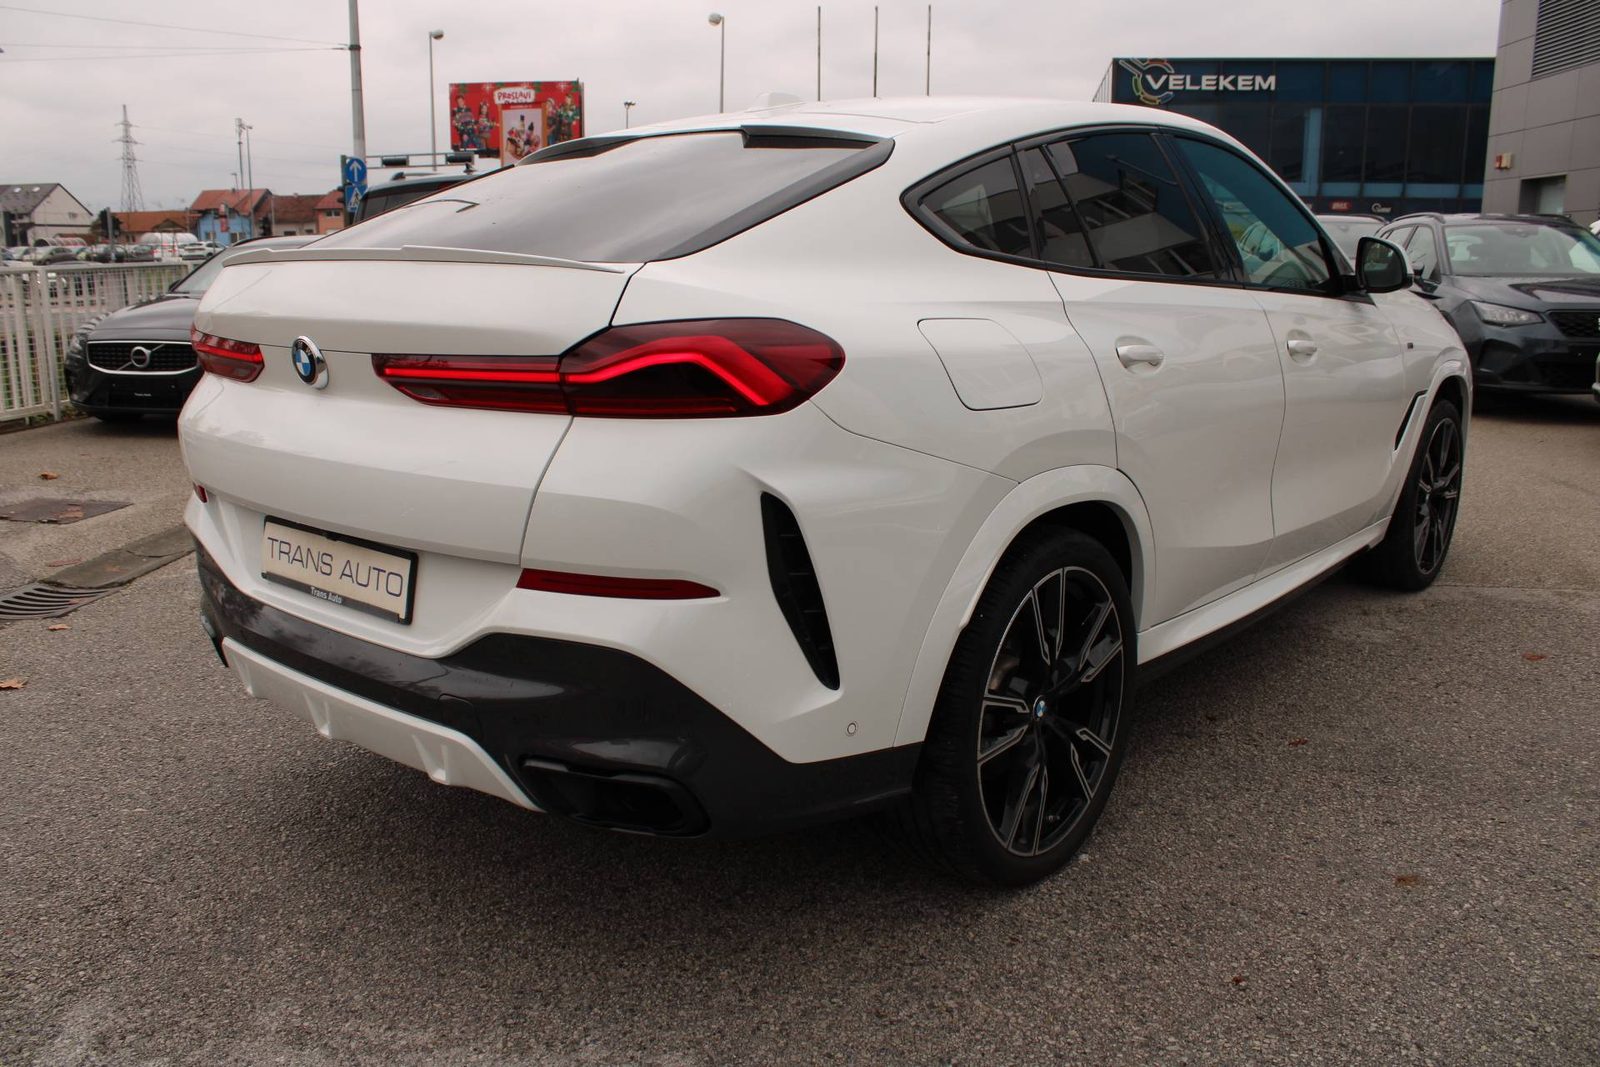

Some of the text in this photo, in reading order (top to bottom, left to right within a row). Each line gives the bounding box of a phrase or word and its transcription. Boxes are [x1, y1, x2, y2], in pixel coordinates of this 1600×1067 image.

[1145, 74, 1277, 91] VELEKEM
[268, 537, 403, 597] TRANS AUTO
[310, 586, 327, 600] Trans
